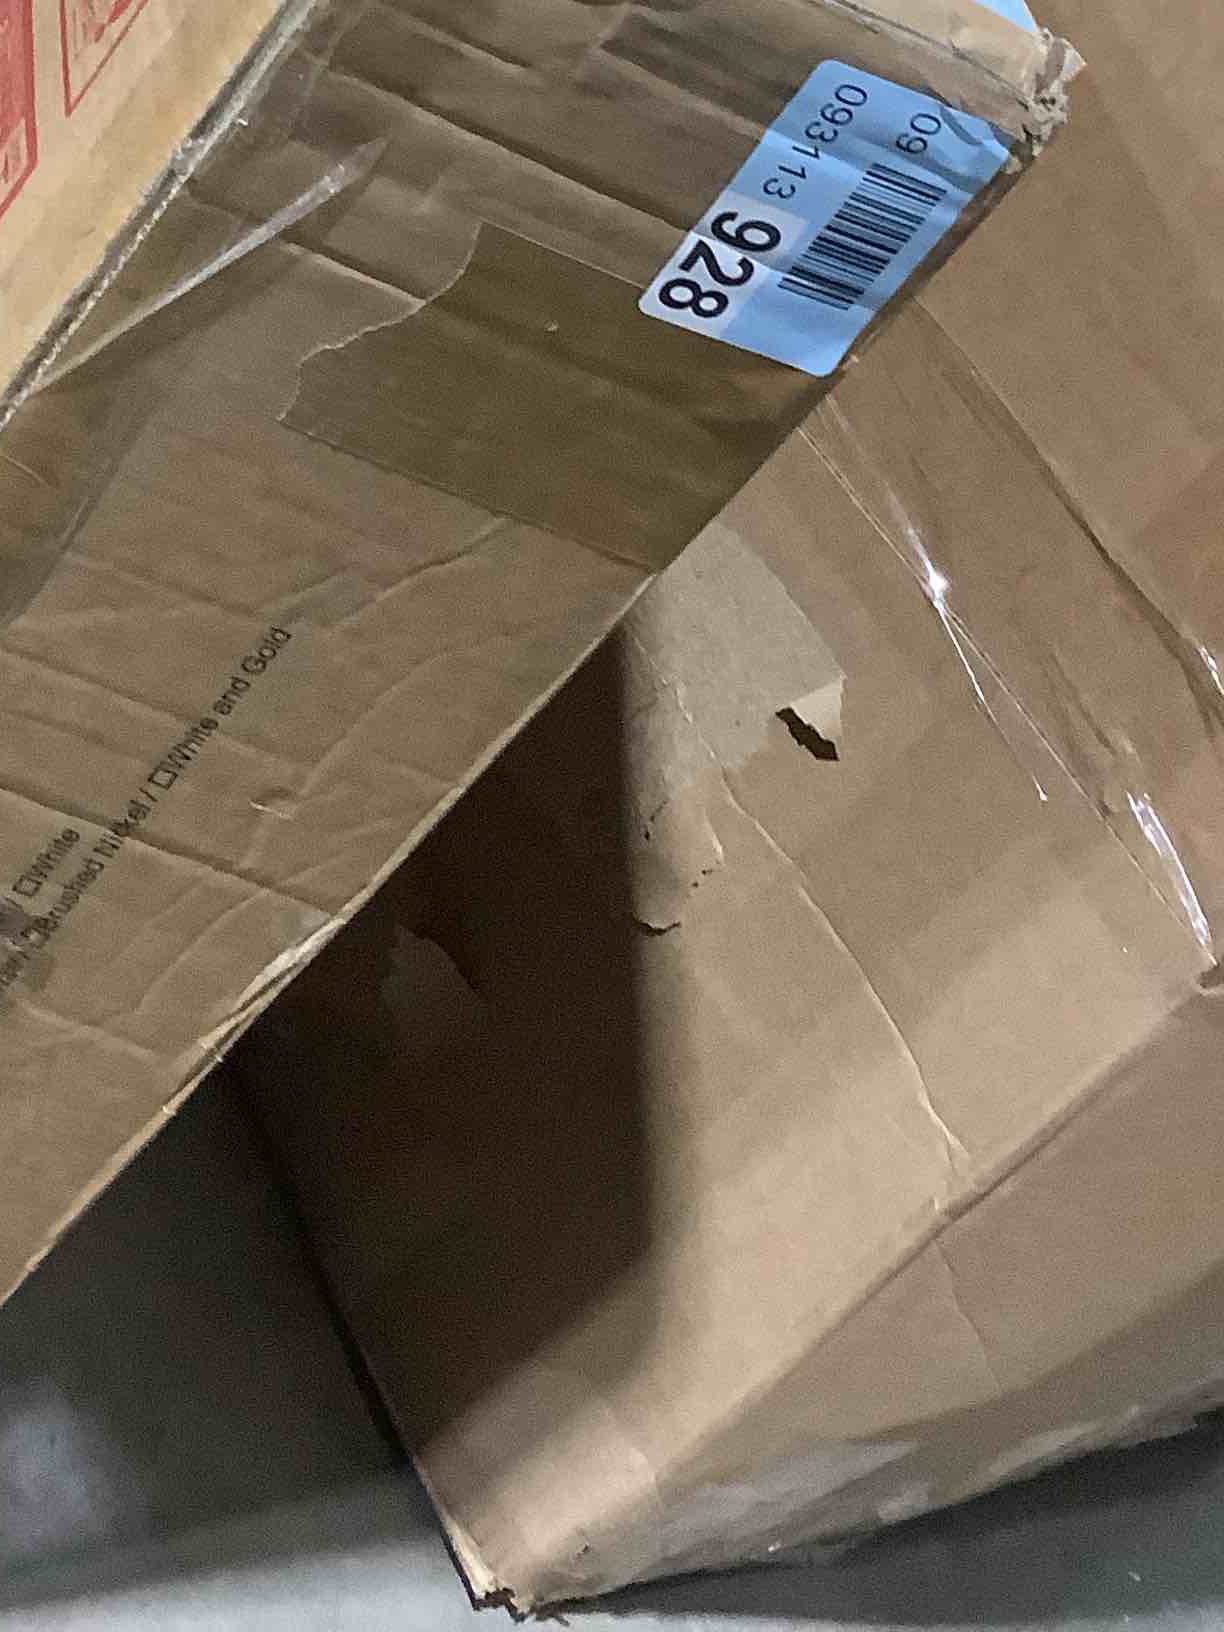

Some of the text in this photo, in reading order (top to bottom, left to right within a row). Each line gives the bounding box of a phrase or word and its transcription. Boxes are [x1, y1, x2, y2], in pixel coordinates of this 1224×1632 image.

[762, 83, 868, 200] 093113
[895, 112, 942, 156] 09
[658, 211, 782, 319] 928
[213, 676, 252, 716] and
[241, 626, 292, 676] Gold
